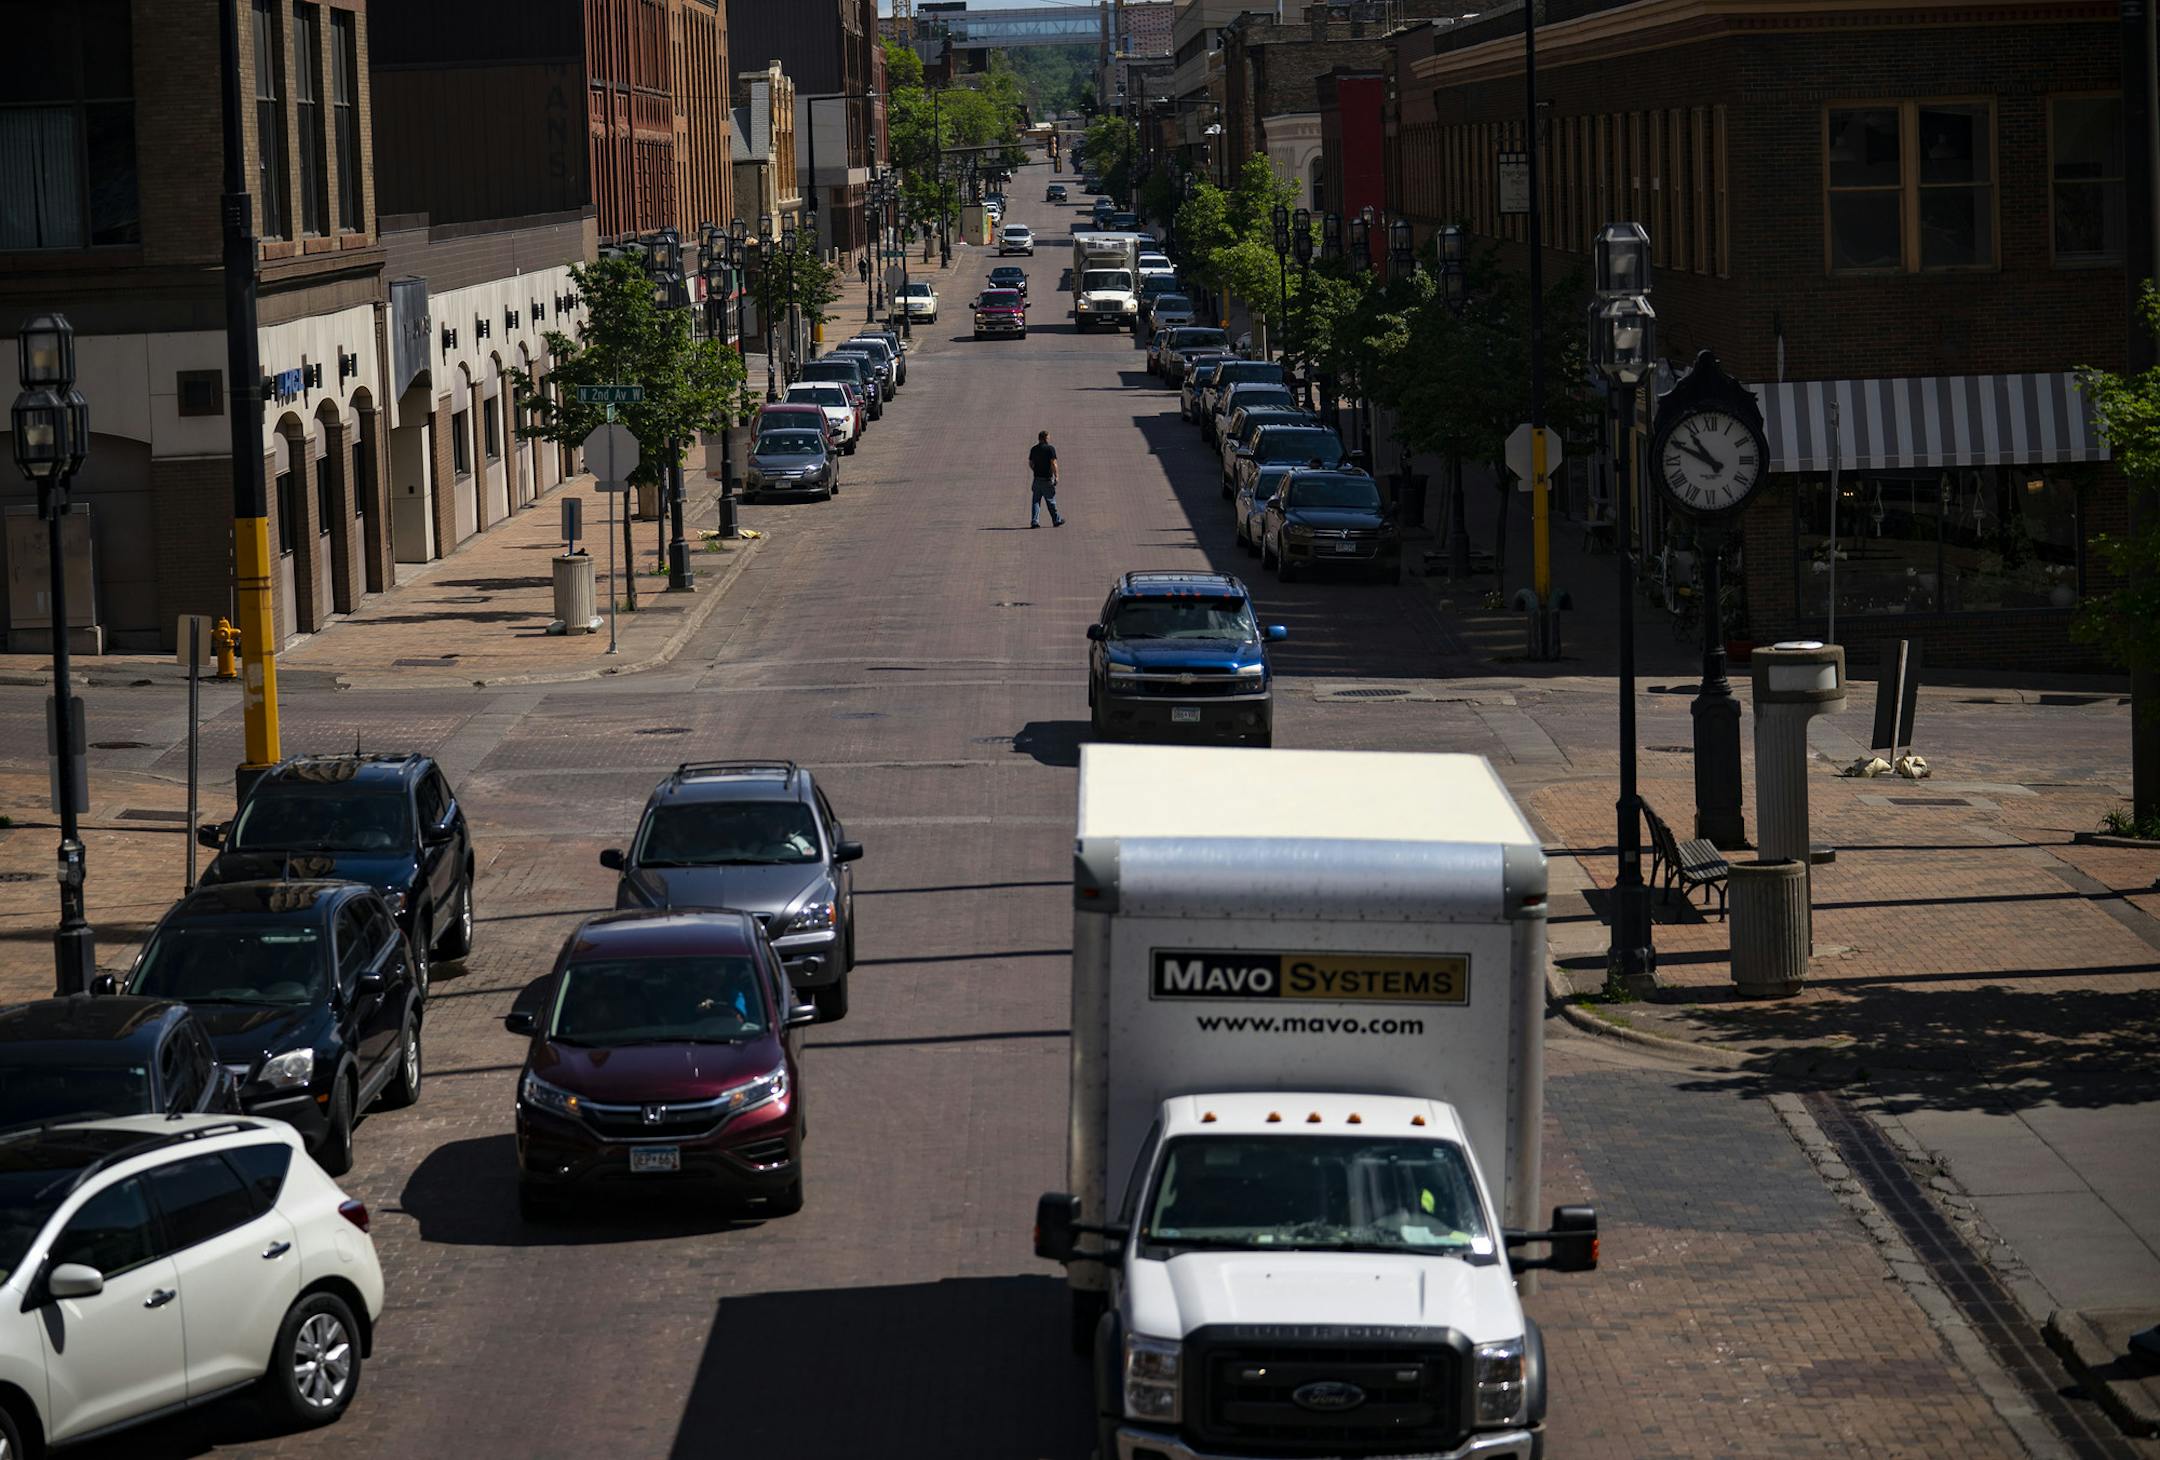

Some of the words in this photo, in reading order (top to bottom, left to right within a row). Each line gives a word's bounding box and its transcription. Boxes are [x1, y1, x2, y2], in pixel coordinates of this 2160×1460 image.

[580, 388, 587, 400] N
[592, 388, 609, 400] 2nd
[614, 388, 627, 400] Av
[631, 388, 641, 400] W
[1162, 959, 1274, 992] MAVO
[1197, 1016, 1424, 1034] www.mavo.com
